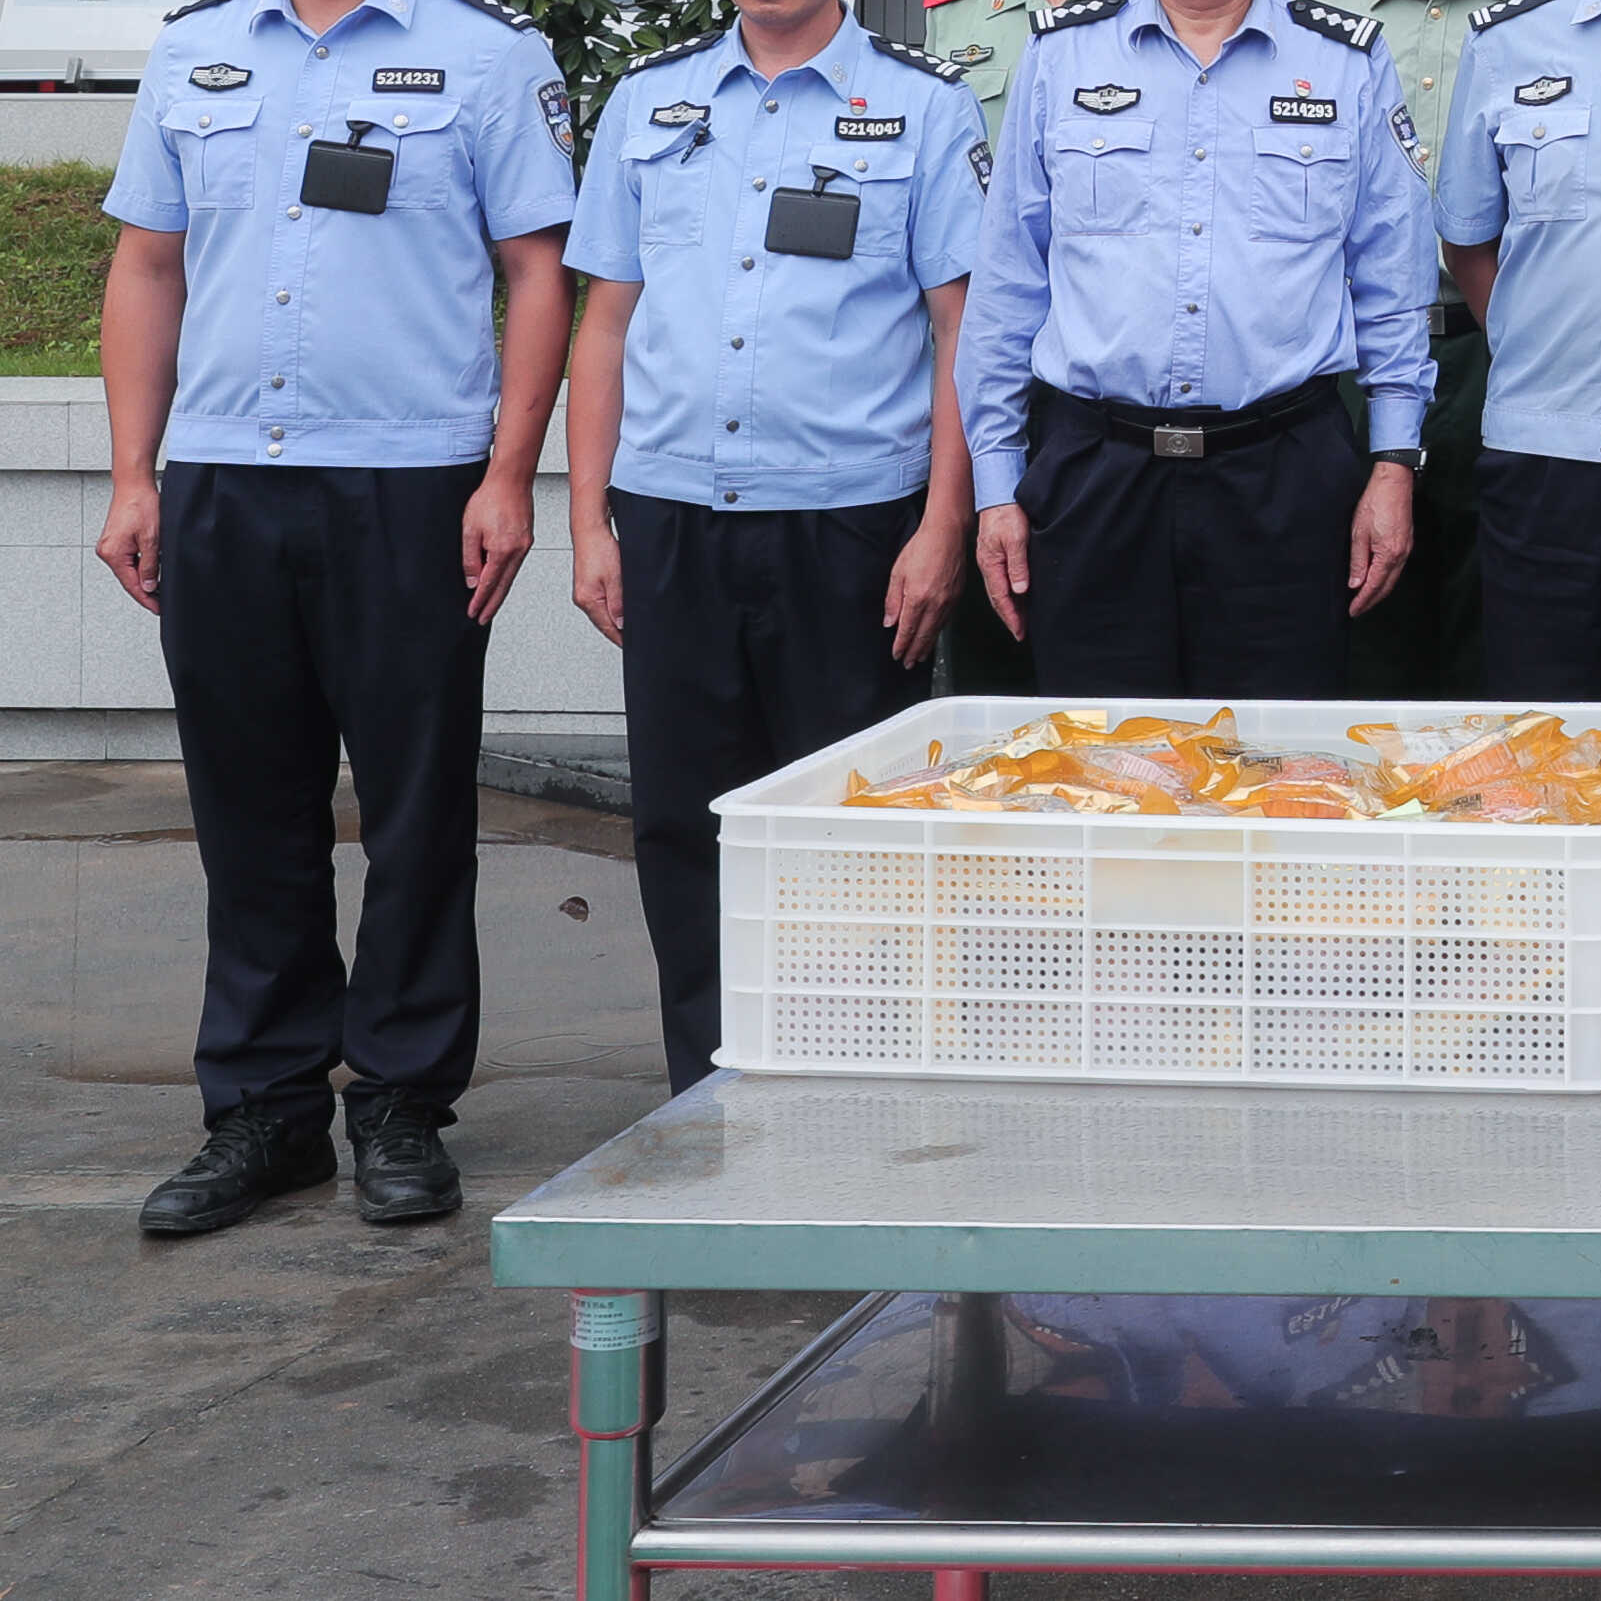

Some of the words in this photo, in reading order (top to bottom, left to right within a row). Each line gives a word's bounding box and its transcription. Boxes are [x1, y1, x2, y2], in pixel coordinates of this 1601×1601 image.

[375, 71, 440, 87] 5214231
[1272, 101, 1334, 118] 5214293
[838, 121, 901, 137] 5214041
